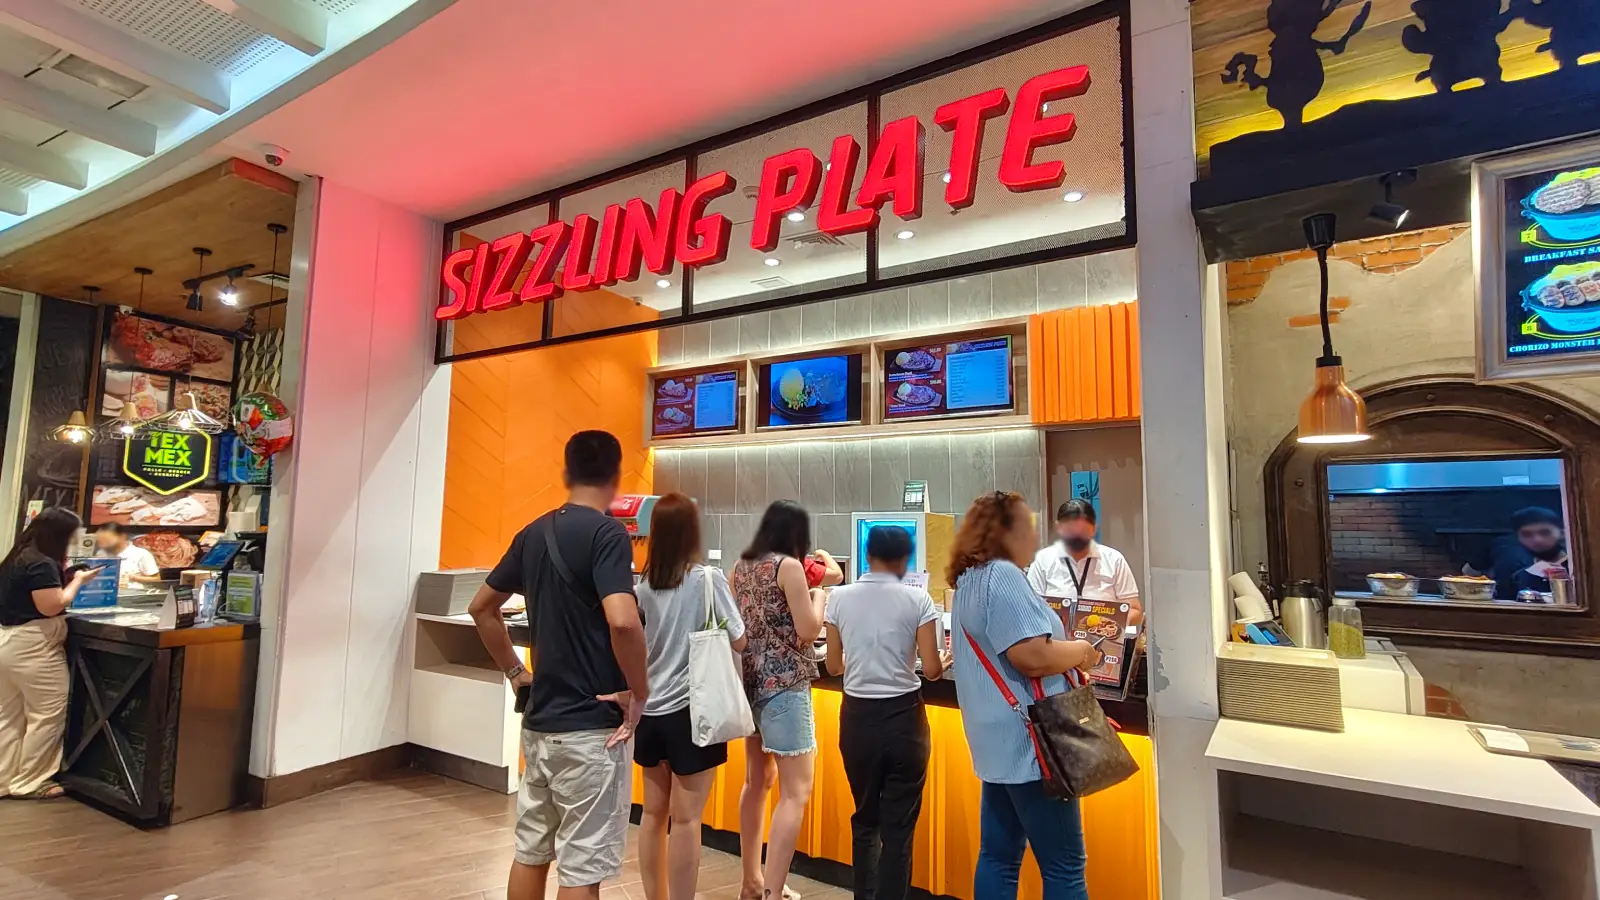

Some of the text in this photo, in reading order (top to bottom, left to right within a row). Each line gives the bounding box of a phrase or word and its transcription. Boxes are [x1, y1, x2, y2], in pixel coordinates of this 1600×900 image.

[434, 64, 1090, 321] SIZZLING PLATE
[1524, 248, 1587, 263] BREAKFAST
[1509, 343, 1549, 353] CHORIZO
[1551, 339, 1595, 349] MONSTER
[148, 431, 190, 450] TEX
[144, 447, 192, 466] MEX
[1092, 606, 1115, 614] SPECIALS
